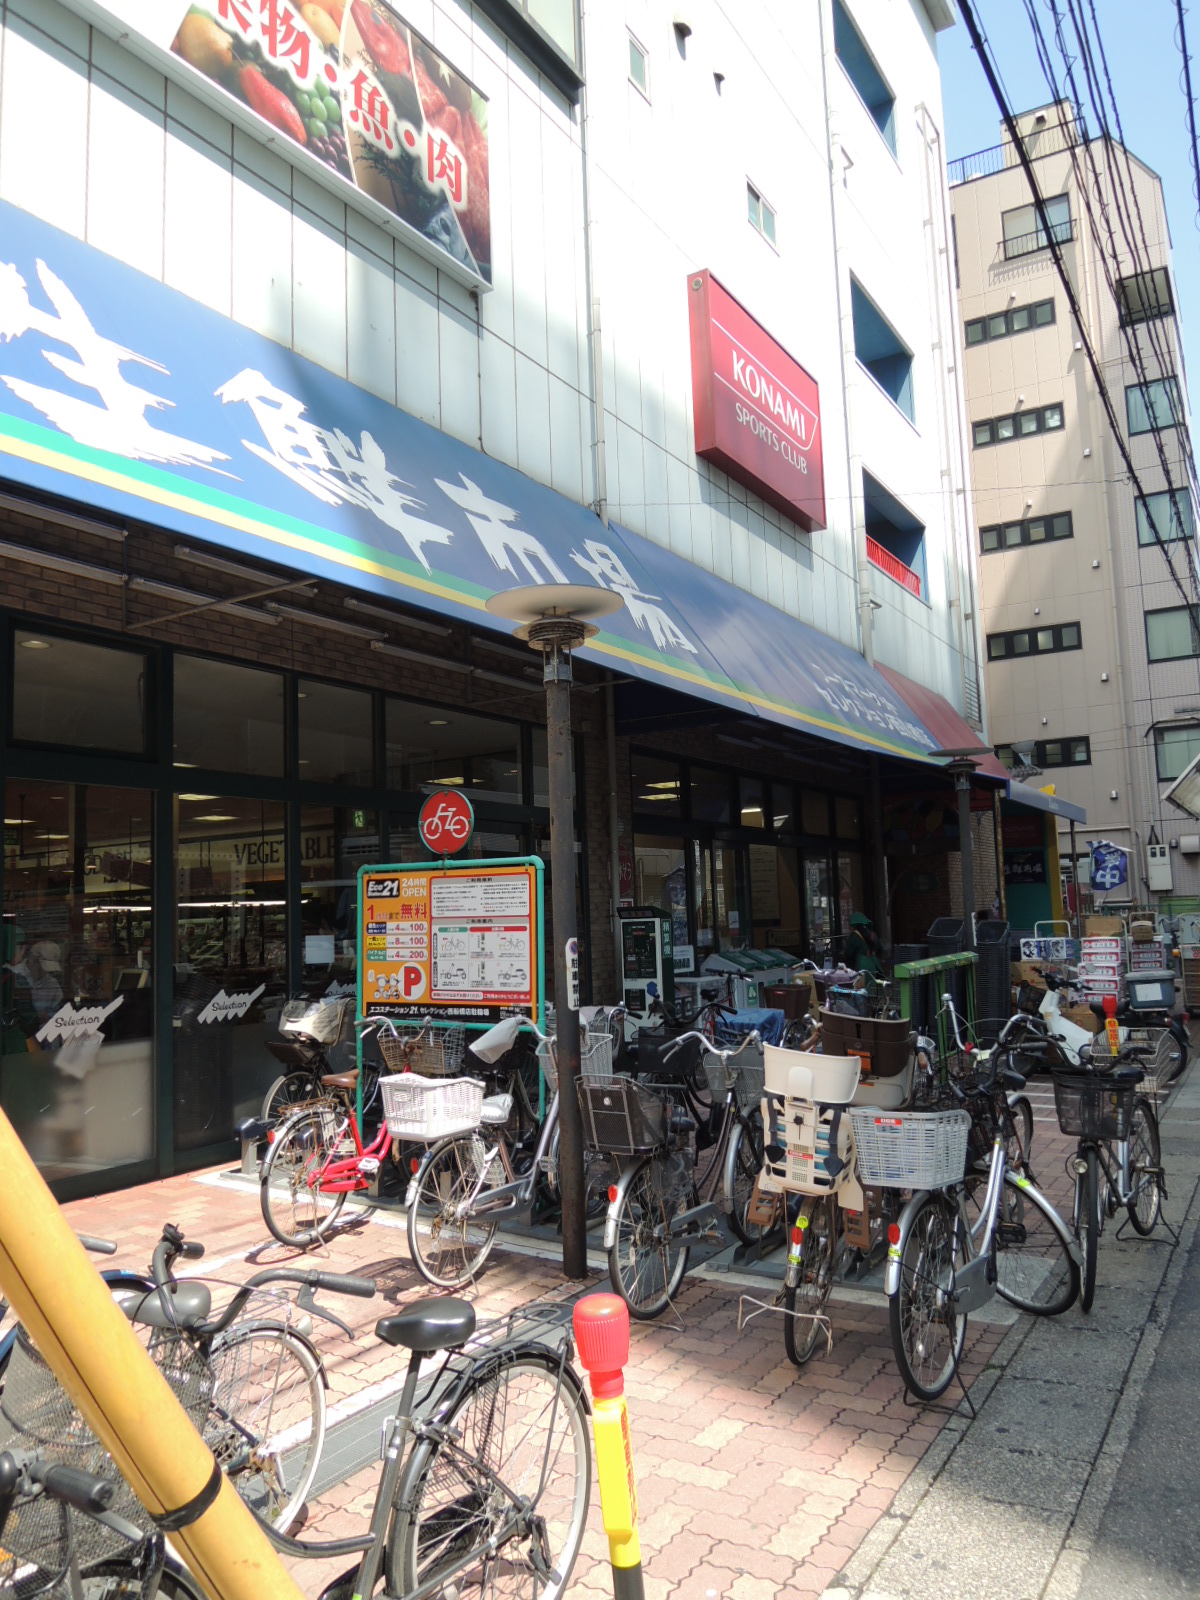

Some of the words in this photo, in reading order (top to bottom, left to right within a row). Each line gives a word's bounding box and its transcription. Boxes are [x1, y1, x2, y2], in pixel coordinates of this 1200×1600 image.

[731, 349, 807, 441] KONAMI
[735, 402, 780, 452] SPORTS
[780, 440, 808, 475] CLUB
[0, 257, 698, 654] 生鮮市場
[402, 878, 427, 888] 24時間
[402, 887, 427, 898] OPEN
[403, 965, 422, 997] P
[211, 1000, 247, 1012] Selection
[369, 1005, 410, 1014] エコステーション
[54, 1014, 100, 1028] Selection
